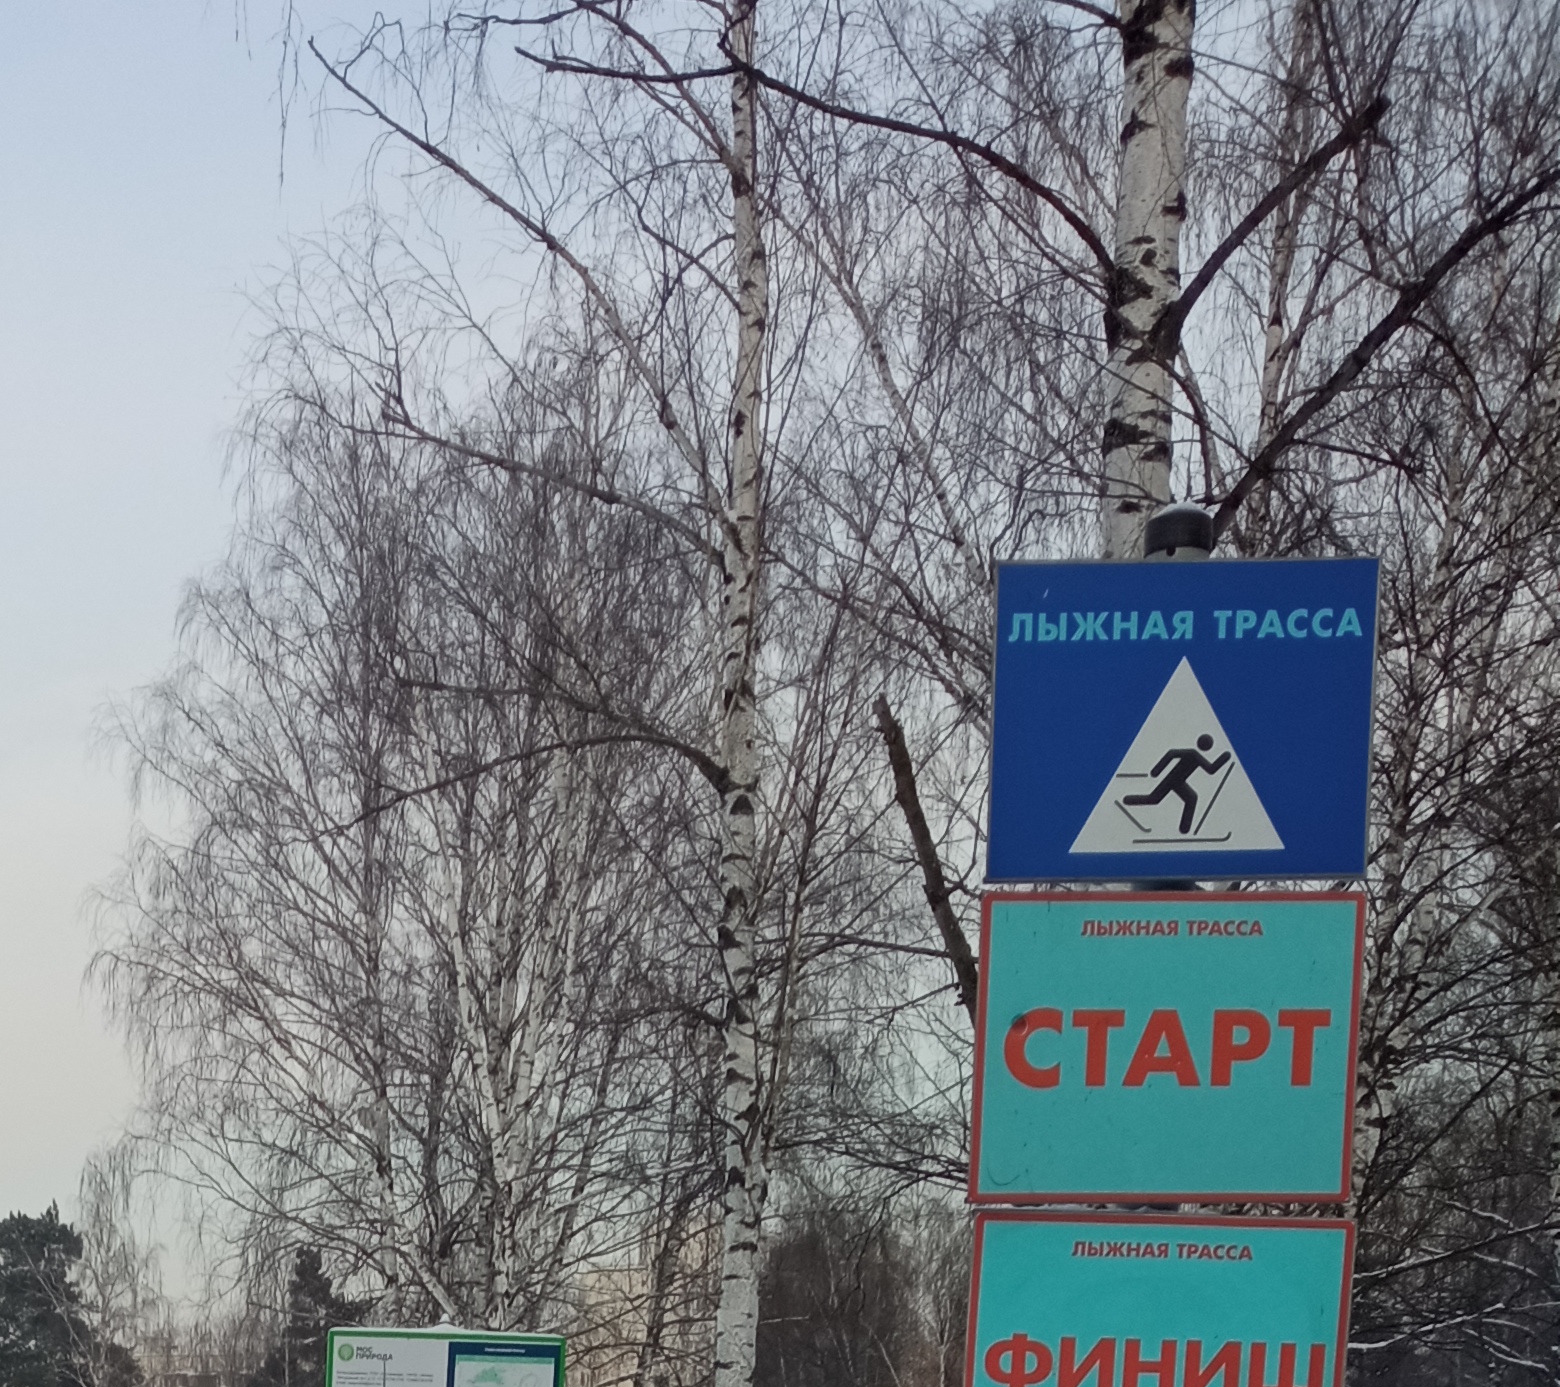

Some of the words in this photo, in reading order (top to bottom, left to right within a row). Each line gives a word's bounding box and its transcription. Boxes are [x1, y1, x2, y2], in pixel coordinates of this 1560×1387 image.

[1008, 610, 1194, 643] ЛЫЖНАЯ
[1213, 607, 1363, 640] ТРАССА
[1080, 919, 1180, 938] ЛЫЖНАЯ
[1186, 919, 1264, 937] ТРАССА
[1002, 1006, 1332, 1090] СТАРТ
[1071, 1240, 1170, 1260] ЛЫЖНАЯ
[1176, 1242, 1254, 1262] ТРАССА
[355, 1346, 373, 1354] МОС
[355, 1353, 393, 1361] ПРИРОДА
